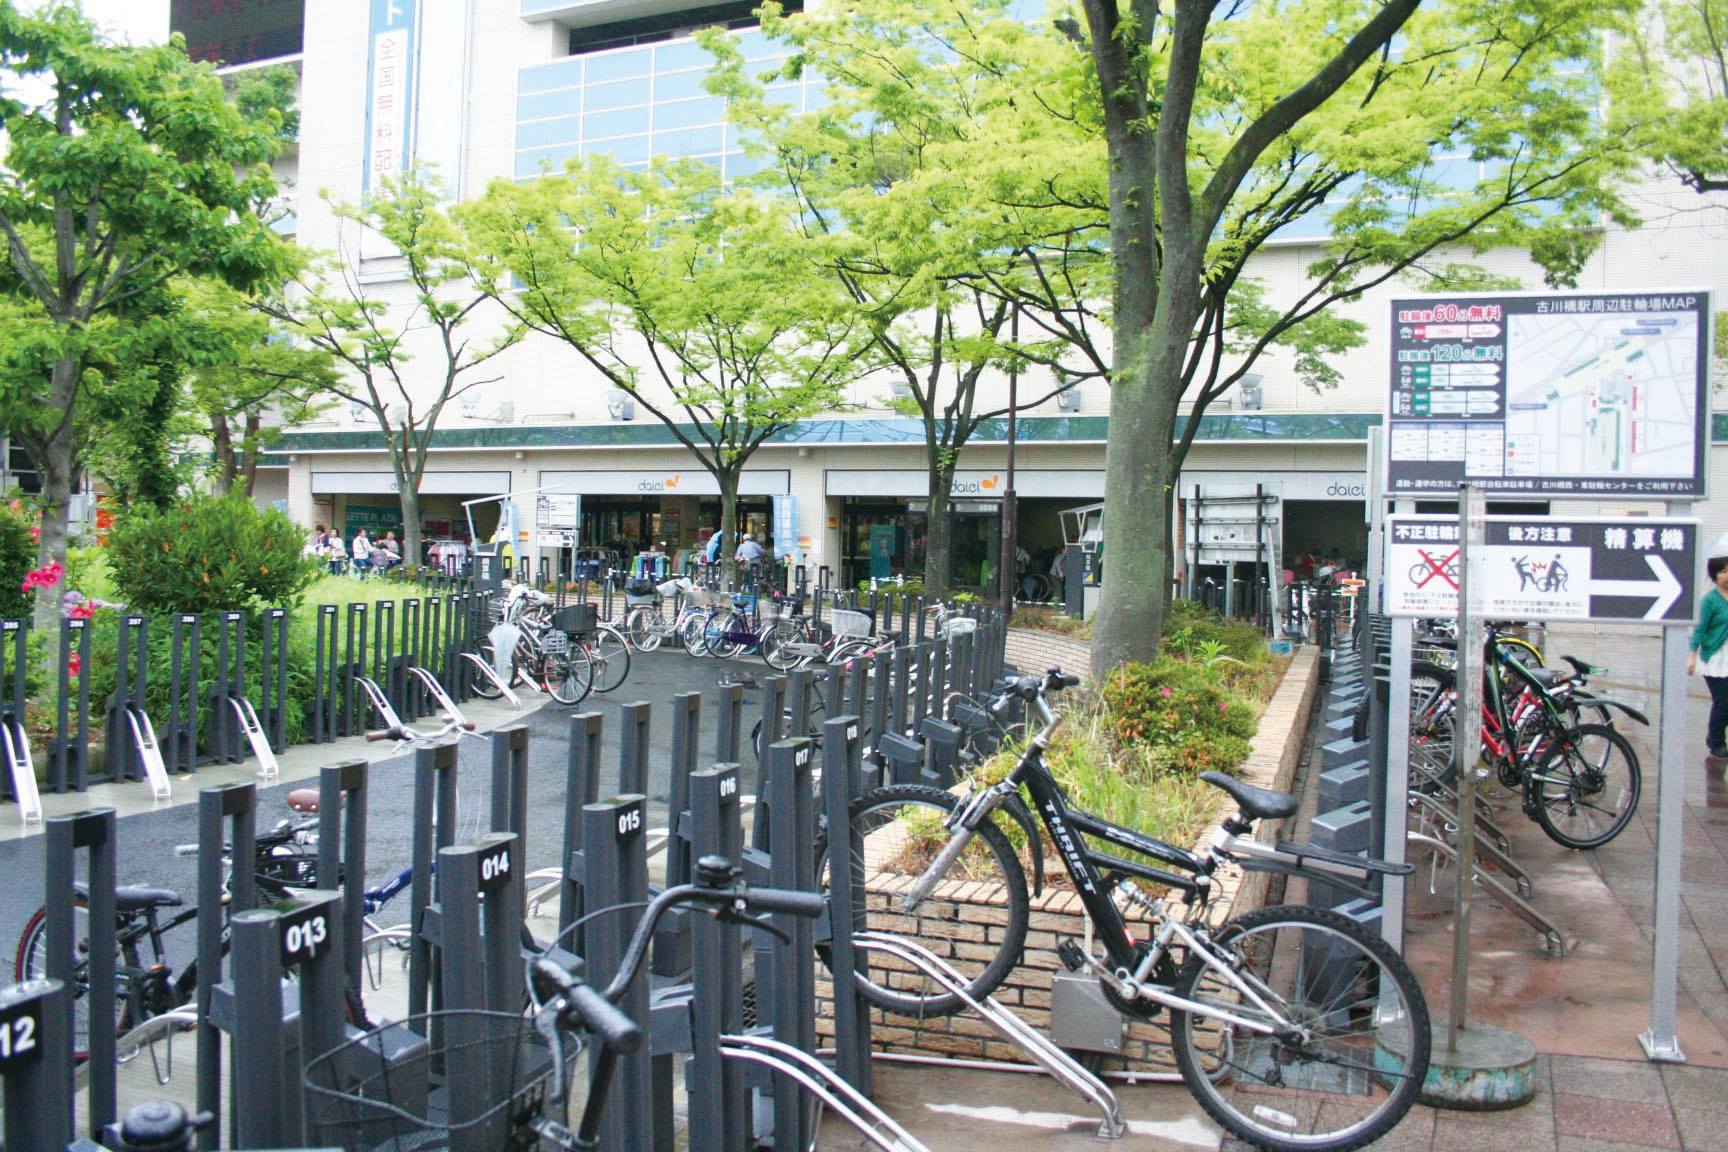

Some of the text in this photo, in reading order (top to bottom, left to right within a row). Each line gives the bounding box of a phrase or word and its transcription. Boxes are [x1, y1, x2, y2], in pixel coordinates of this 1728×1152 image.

[375, 38, 396, 198] 全国無料配
[1326, 481, 1366, 497] daiei
[1395, 525, 1459, 540] 不正駐輪
[1508, 526, 1572, 542] 後方注意
[1604, 527, 1685, 551] 精算機
[795, 748, 809, 767] 017
[720, 777, 736, 797] 016
[618, 809, 640, 834] 015
[1045, 799, 1097, 895] THRIFT
[482, 851, 509, 880] 014
[286, 915, 327, 954] 013
